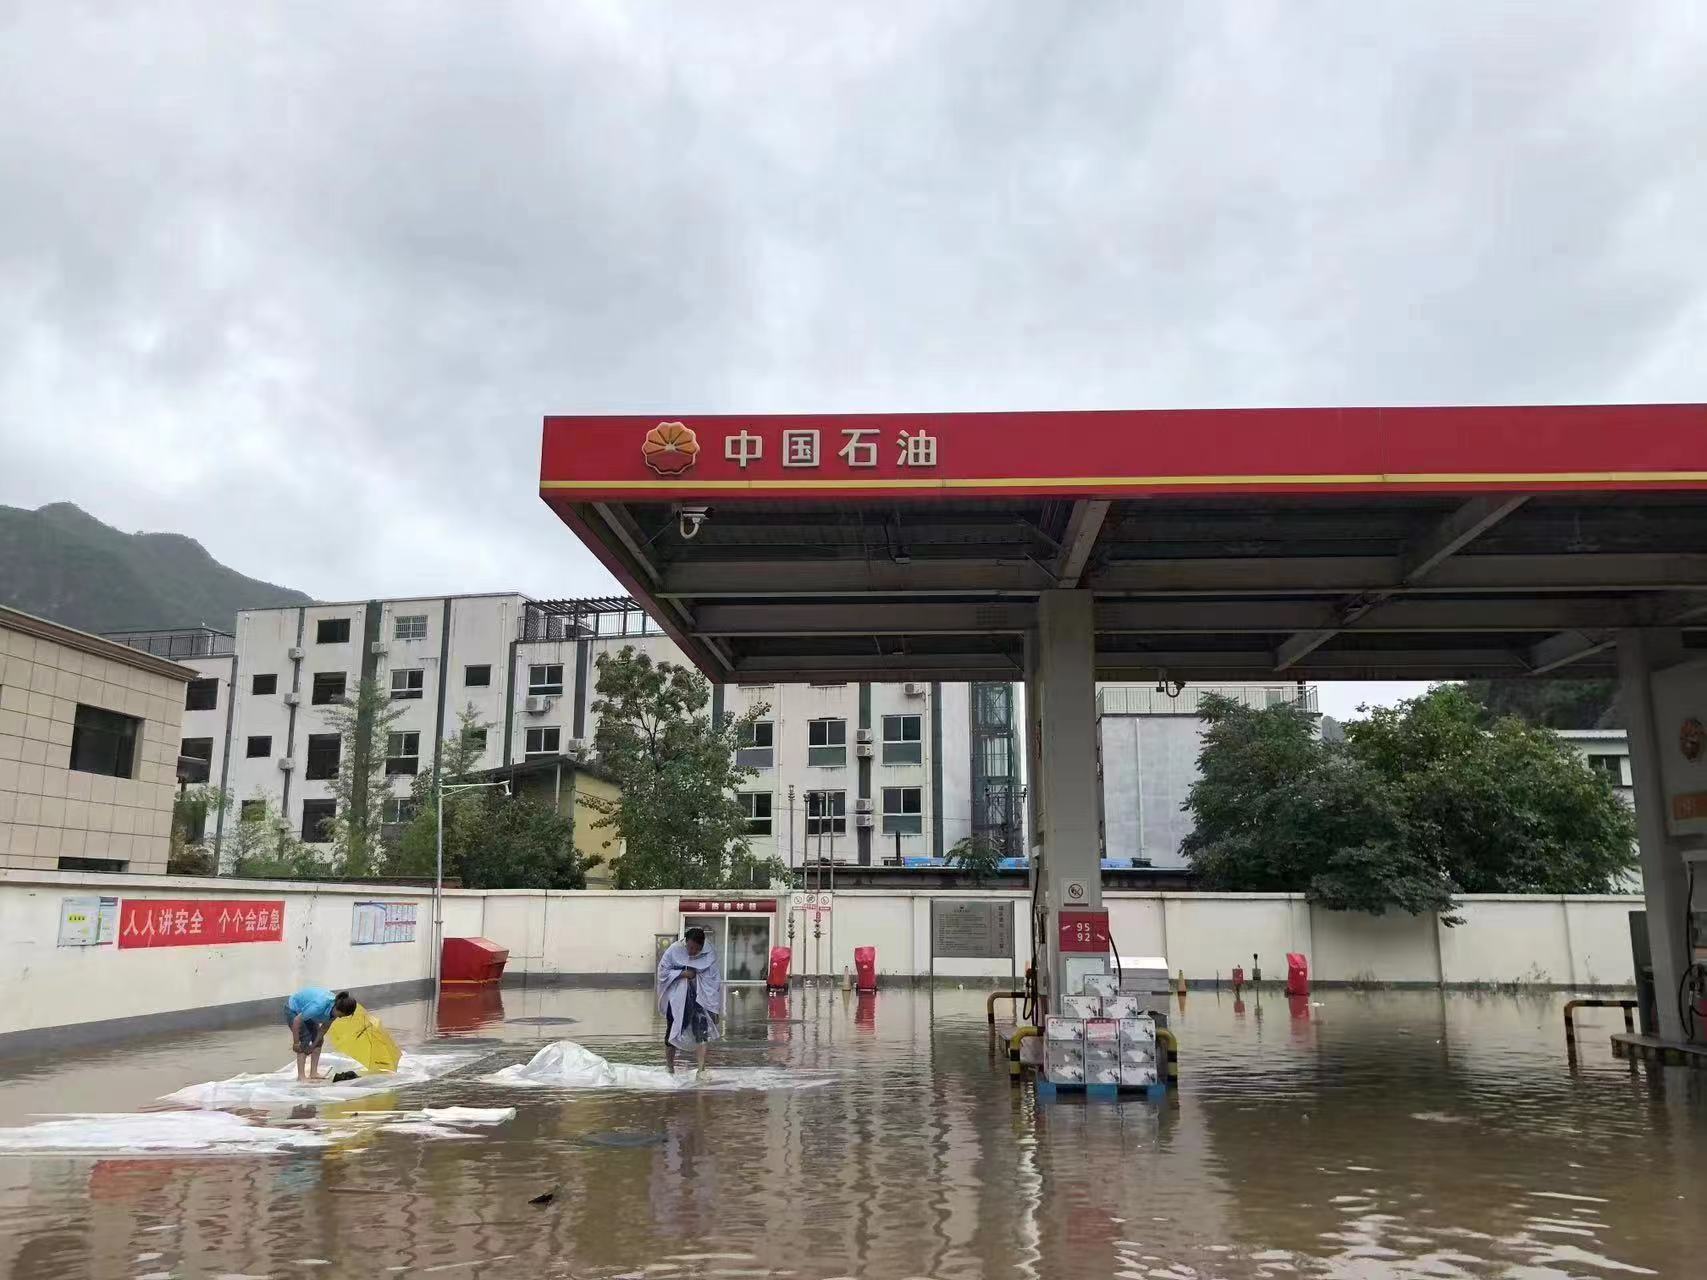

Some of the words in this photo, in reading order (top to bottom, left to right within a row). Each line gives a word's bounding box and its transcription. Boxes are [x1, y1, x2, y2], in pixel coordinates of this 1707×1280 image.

[725, 429, 937, 468] 中国石油
[123, 908, 204, 936] 人人讲安全
[218, 908, 281, 933] 个个会应急
[1076, 922, 1090, 932] 95
[1077, 932, 1090, 942] 92
